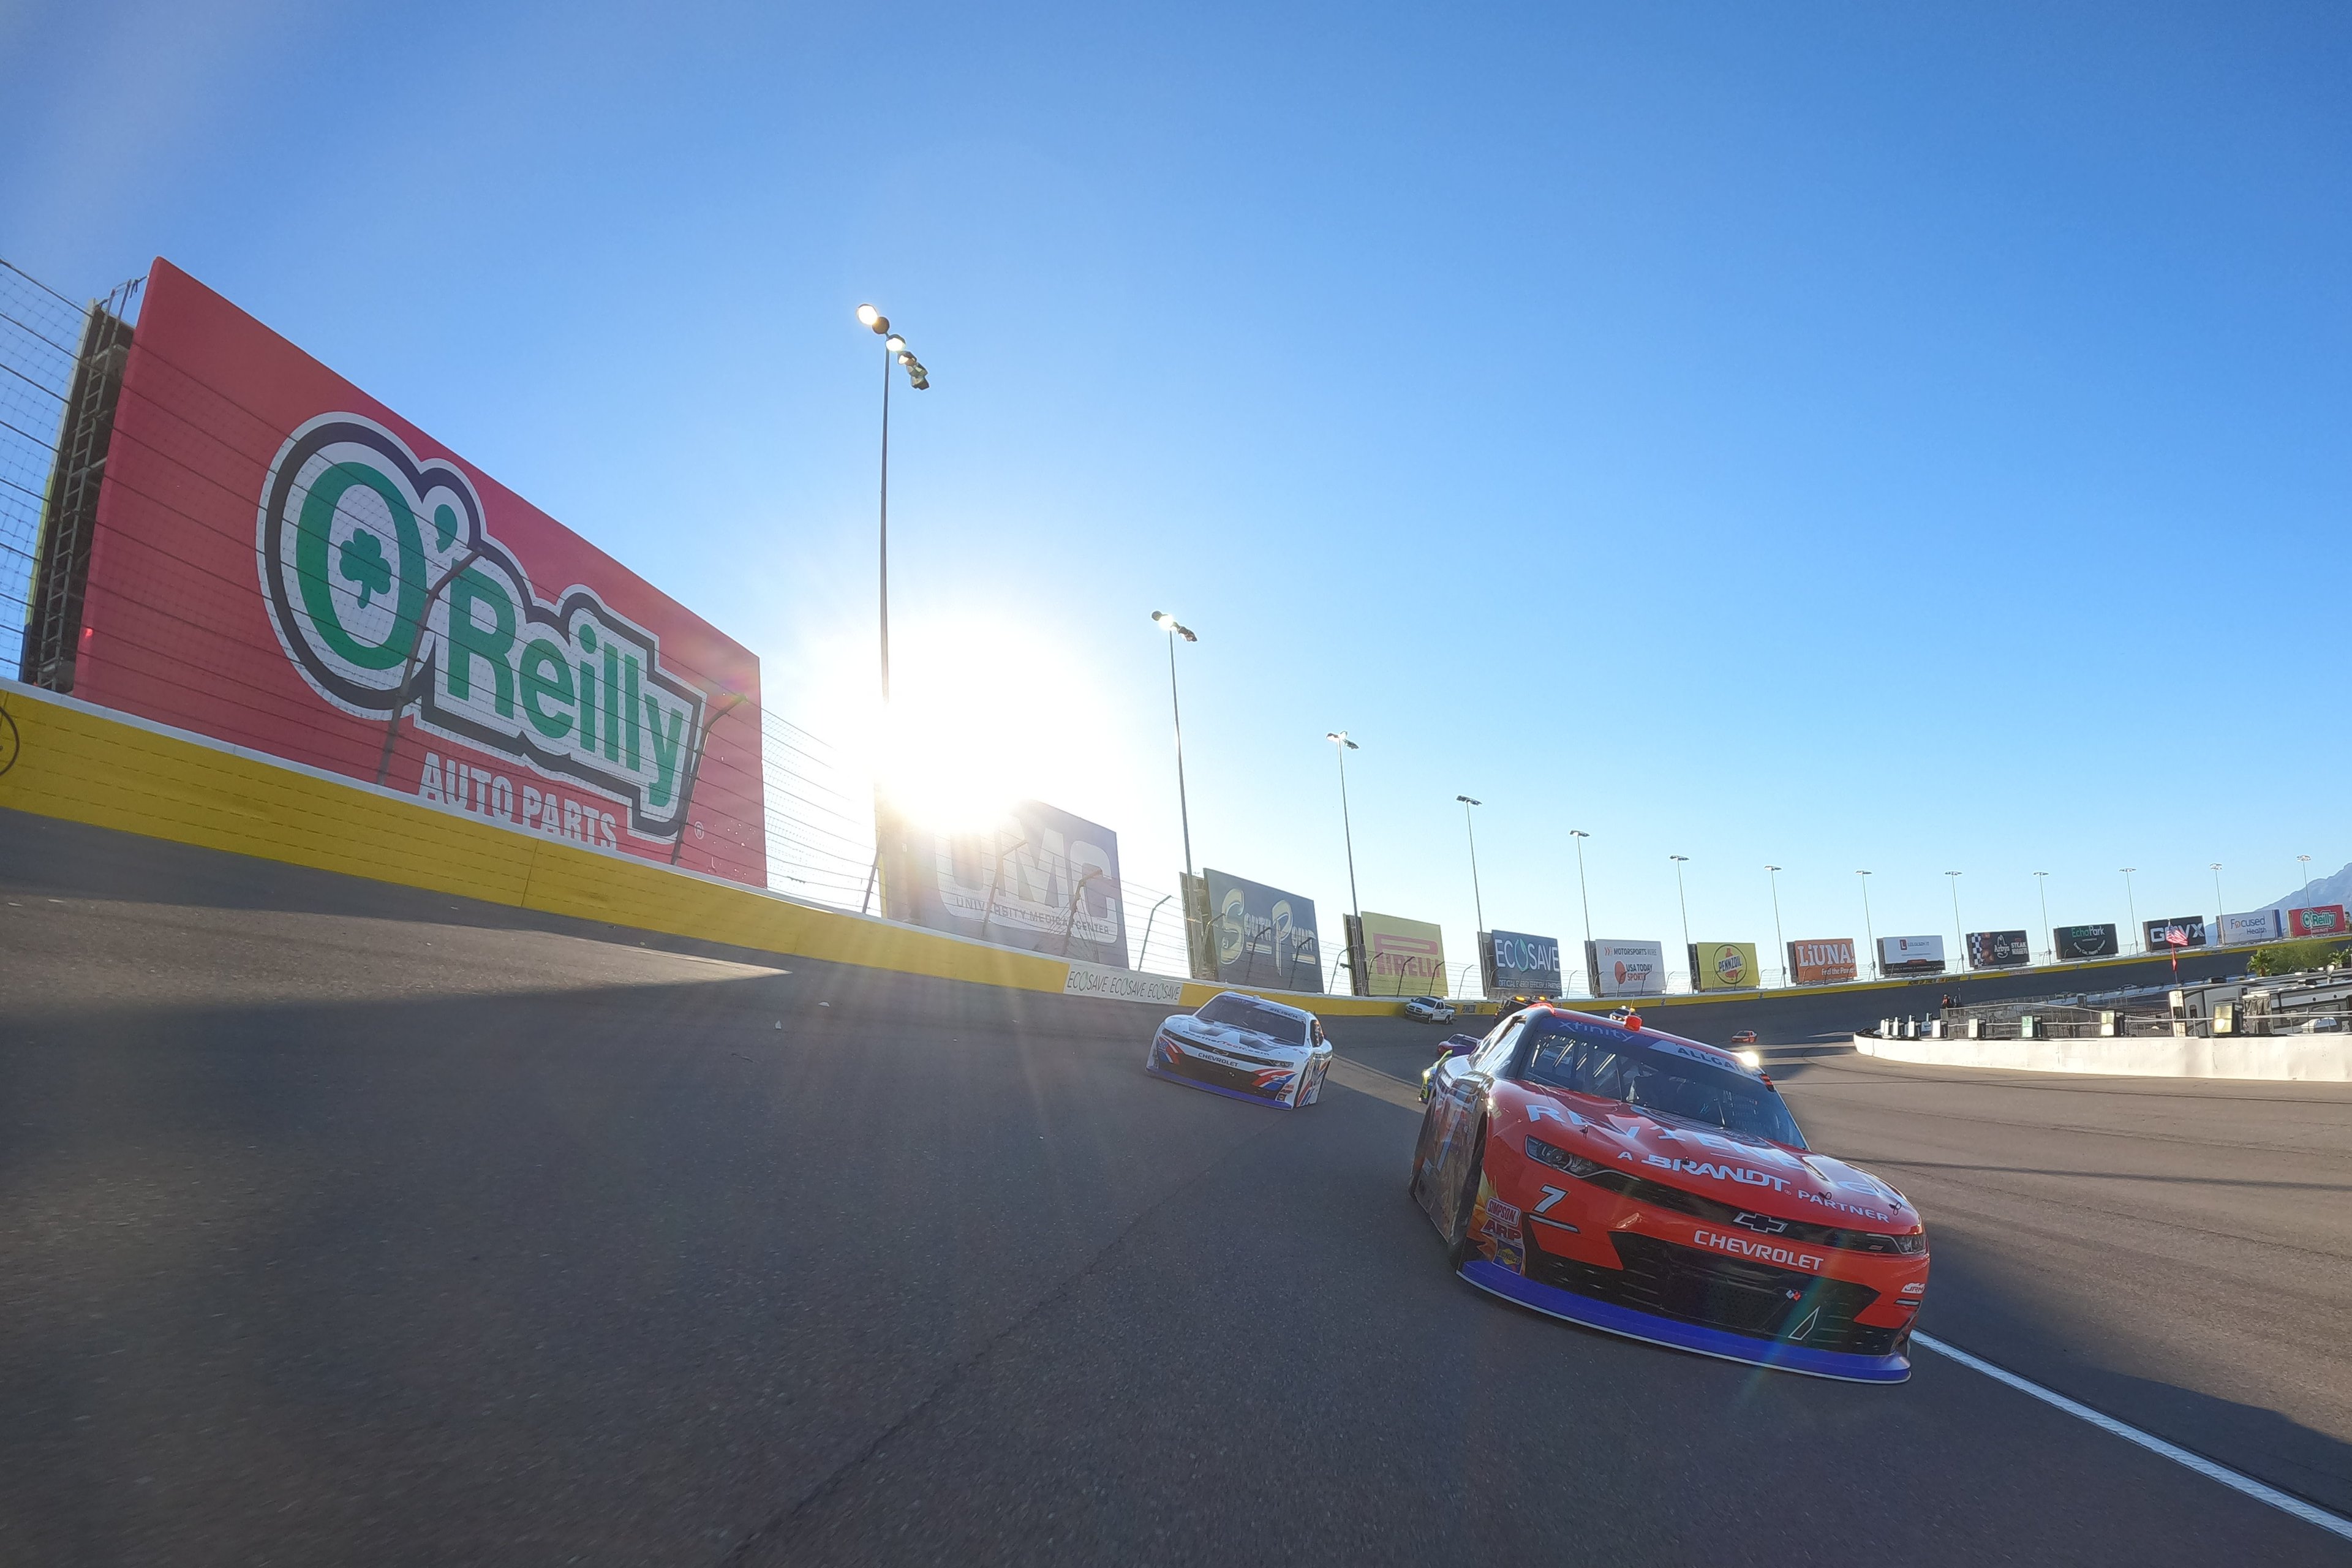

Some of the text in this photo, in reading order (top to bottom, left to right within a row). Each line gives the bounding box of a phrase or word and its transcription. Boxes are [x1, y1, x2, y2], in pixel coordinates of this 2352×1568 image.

[295, 461, 683, 807] O'Reilly
[419, 752, 616, 850] AUTO PARTS
[934, 816, 1118, 943] UMC
[956, 896, 1025, 919] UNIVRSITY
[1030, 911, 1070, 926] MEDICA
[2231, 916, 2266, 929] Focused
[2071, 925, 2105, 937] EchoPark
[1373, 933, 1441, 978] PIRELLI
[1494, 938, 1559, 972] ECOSAVE
[1719, 956, 1741, 972] PENNZOIL
[1798, 944, 1855, 967] LiUNA!
[1067, 971, 1180, 1000] ECOSAVE ECOSAVE ECOSAVE
[1559, 1021, 1635, 1042] xfinity
[1198, 1052, 1238, 1066] CHEVROLET
[1533, 1185, 1568, 1213] 7
[1617, 1151, 1890, 1224] A BRANDT PARTNER
[1488, 1200, 1517, 1223] SIMPSON
[1481, 1219, 1522, 1241] ARP
[1694, 1230, 1824, 1270] CHEVROLET
